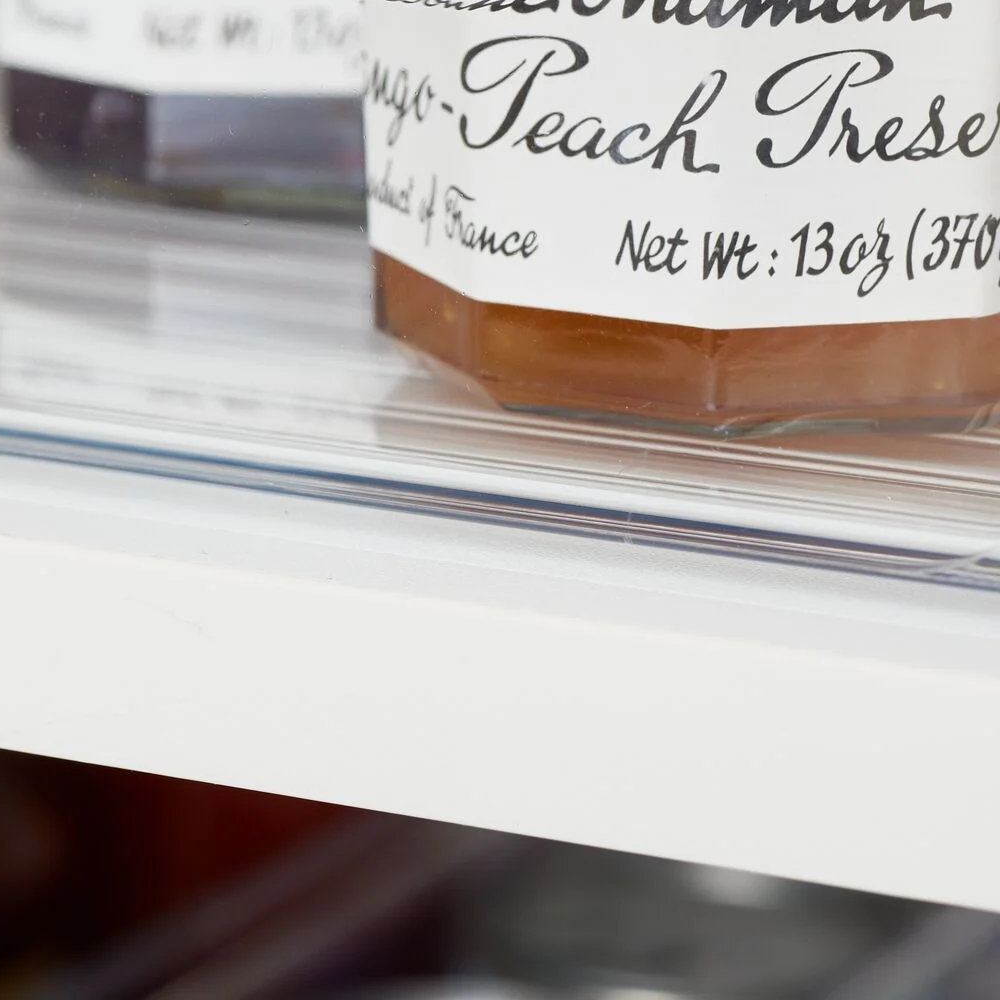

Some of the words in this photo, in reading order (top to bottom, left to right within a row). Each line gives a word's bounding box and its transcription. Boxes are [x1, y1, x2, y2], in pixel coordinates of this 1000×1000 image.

[361, 35, 720, 174] ngo-Peach
[754, 48, 1000, 169] Prese
[444, 184, 540, 259] France
[615, 218, 690, 276] Net
[905, 207, 1000, 287] (370
